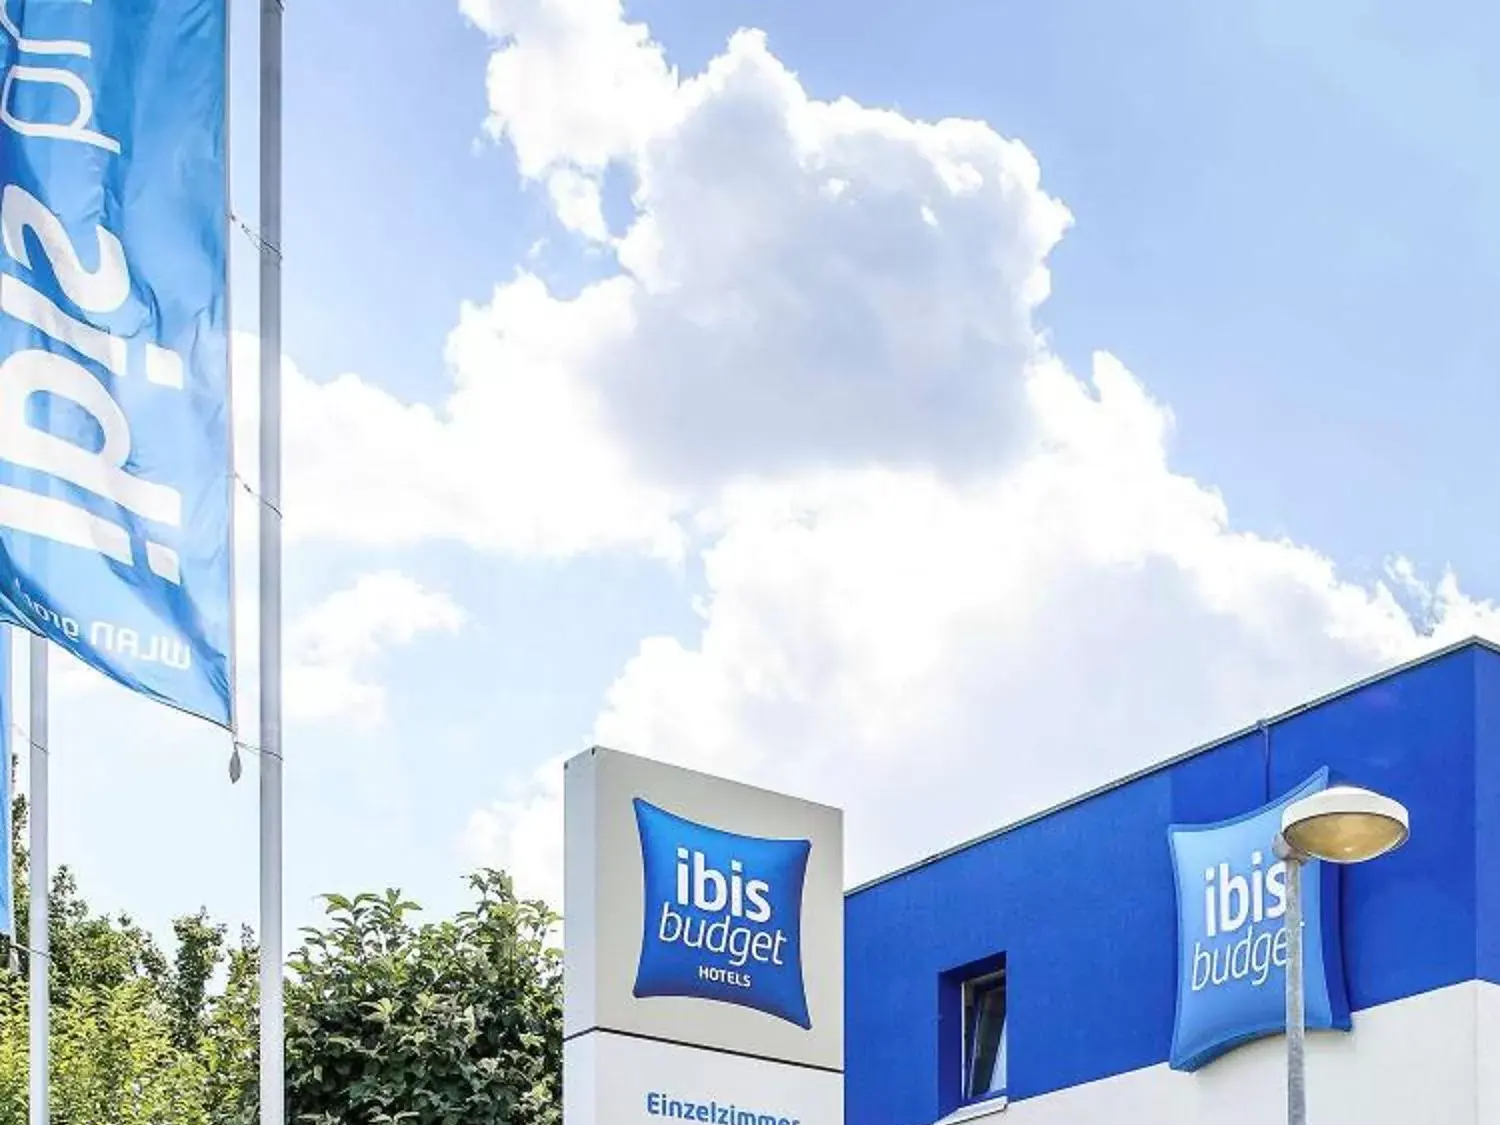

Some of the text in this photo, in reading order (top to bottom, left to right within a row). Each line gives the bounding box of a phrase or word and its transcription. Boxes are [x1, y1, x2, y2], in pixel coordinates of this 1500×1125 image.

[677, 847, 772, 923] ibis
[1204, 851, 1287, 937] ibis
[658, 902, 787, 966] budget
[1191, 920, 1306, 991] budge
[699, 966, 751, 988] HOTELS
